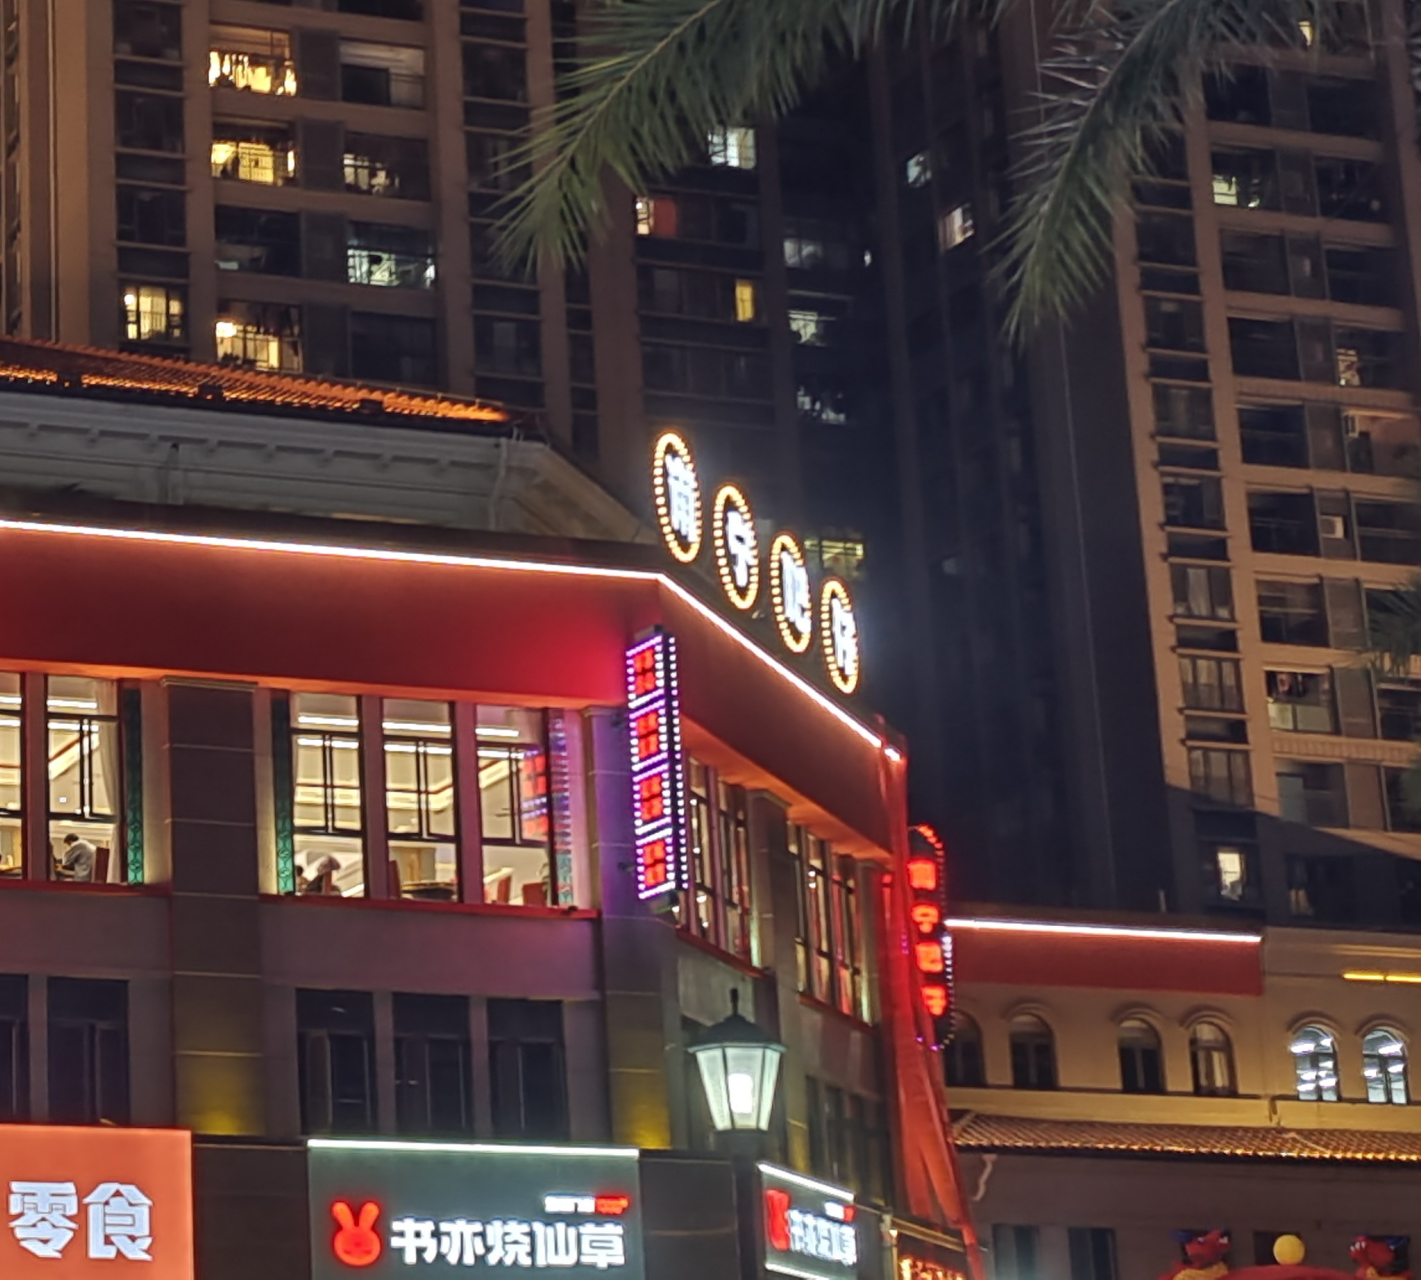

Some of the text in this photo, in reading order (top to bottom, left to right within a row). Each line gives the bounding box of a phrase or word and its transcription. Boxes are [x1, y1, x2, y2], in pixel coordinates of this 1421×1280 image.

[390, 1217, 627, 1269] 书亦烧仙草
